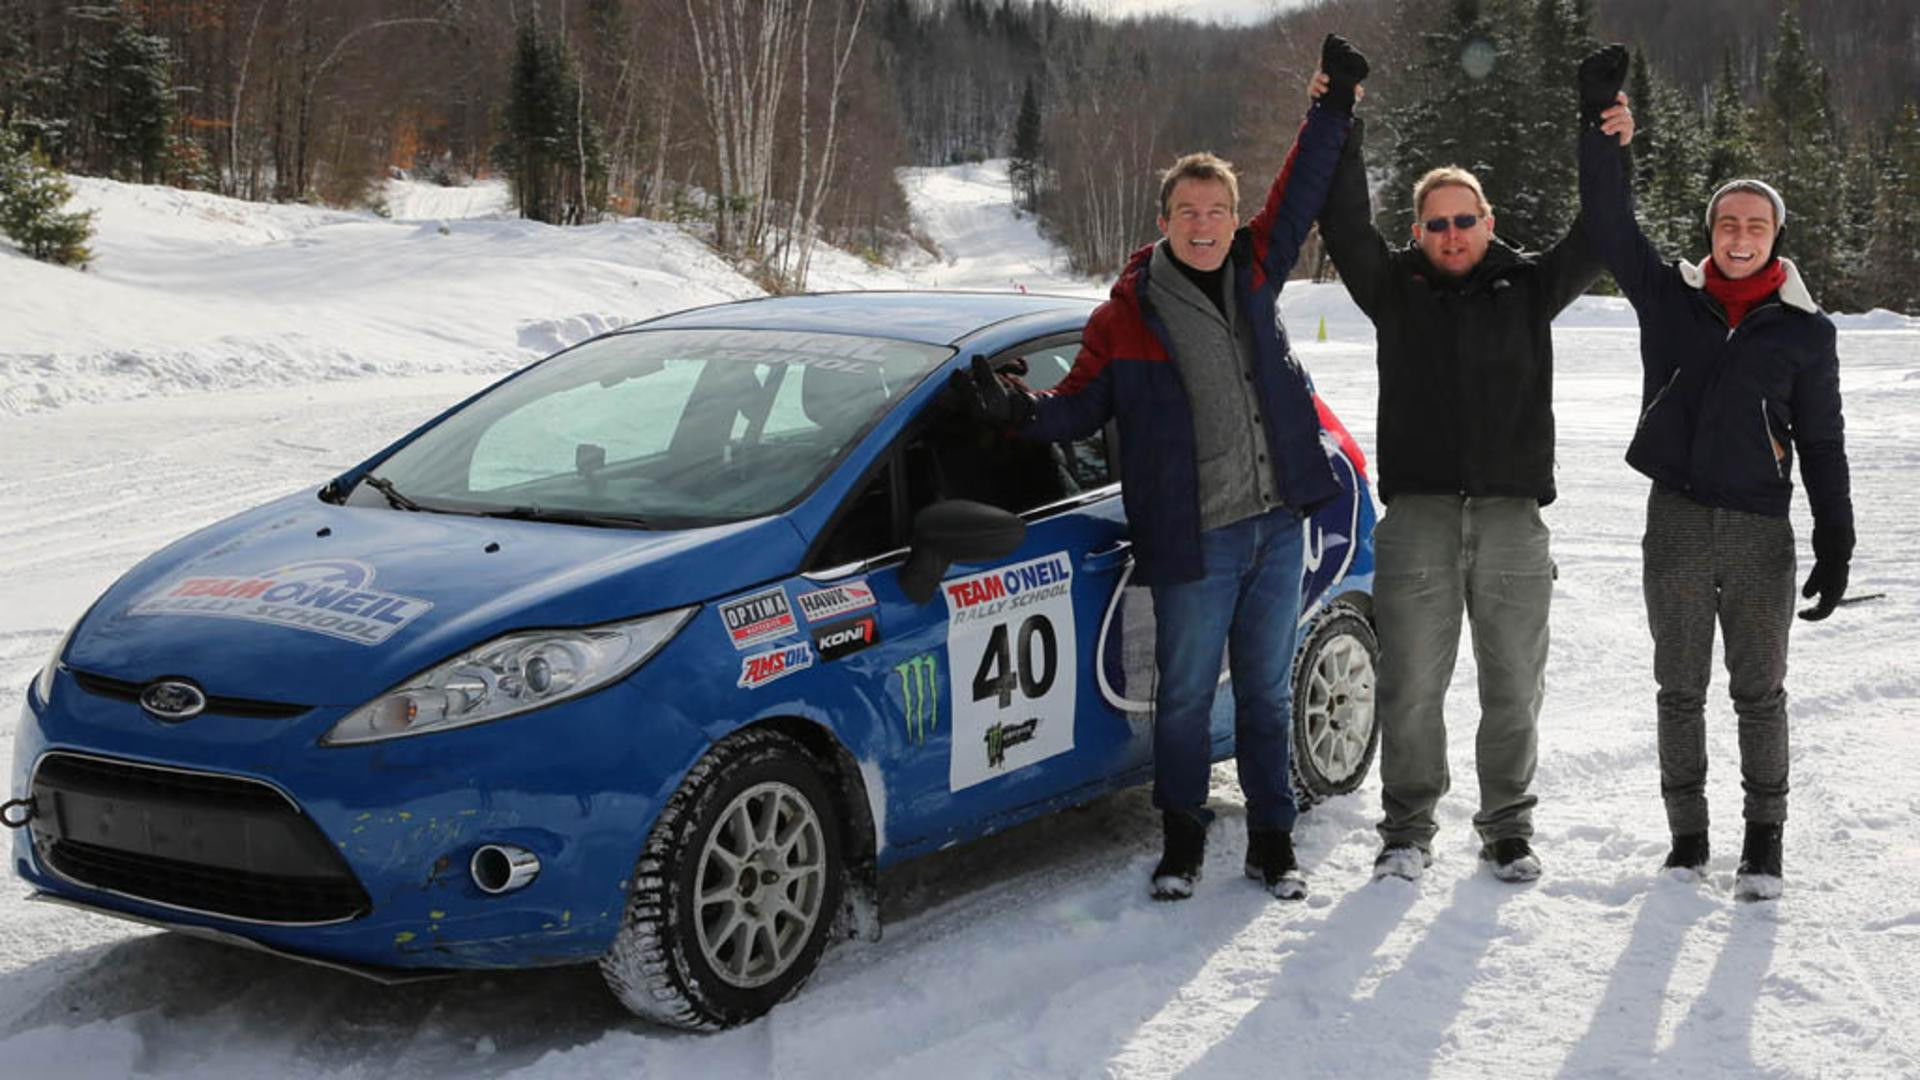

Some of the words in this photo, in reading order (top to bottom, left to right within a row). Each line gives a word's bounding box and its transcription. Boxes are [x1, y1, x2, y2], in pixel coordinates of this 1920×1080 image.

[168, 577, 275, 599] TEAM
[801, 588, 849, 612] HAWK
[947, 575, 1005, 608] TEAM
[1002, 558, 1069, 595] O'NEIL
[247, 604, 384, 640] SCHOOL
[727, 594, 787, 628] OPTIMA
[954, 602, 1006, 625] RALLY
[1009, 584, 1068, 610] SCHOOL
[743, 647, 812, 683] AMSOIL
[972, 613, 1057, 709] 40
